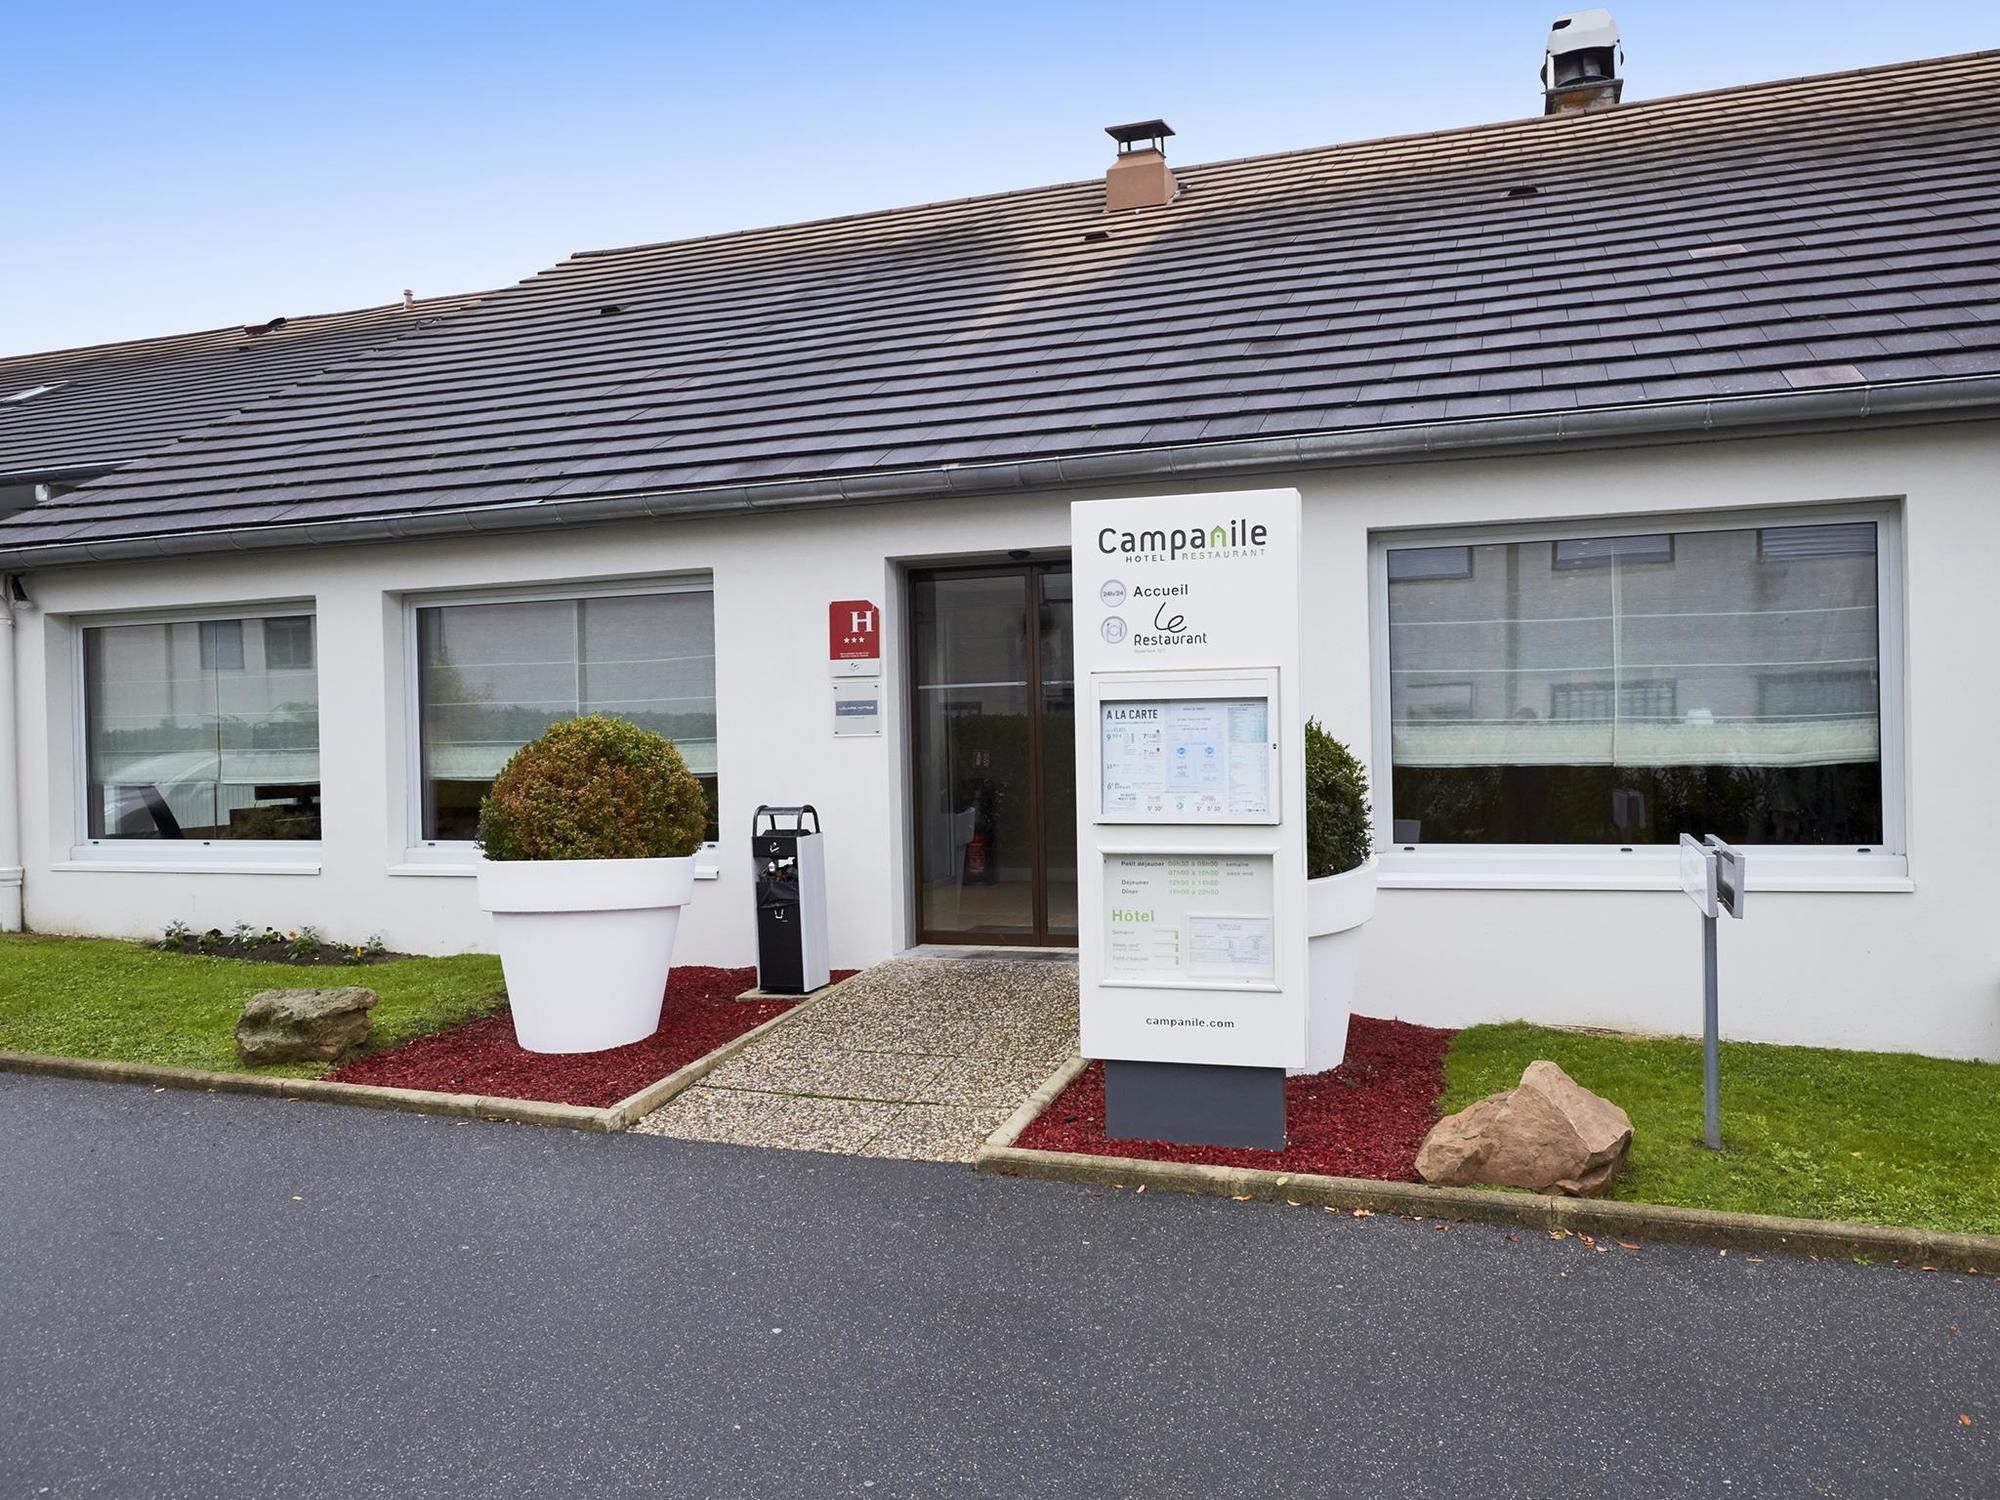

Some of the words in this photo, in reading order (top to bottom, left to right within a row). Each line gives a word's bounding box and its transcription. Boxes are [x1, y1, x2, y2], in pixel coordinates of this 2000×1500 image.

[1098, 519, 1268, 560] Campanile
[1126, 554, 1166, 563] HOTEL
[1182, 549, 1266, 560] RESTAURANT
[1133, 584, 1189, 597] Accueil
[850, 611, 874, 633] H
[1134, 632, 1207, 646] Restaurant
[1106, 710, 1112, 720] A
[1115, 710, 1126, 720] LA
[1129, 709, 1158, 719] CARTE
[1112, 909, 1154, 922] Hôtel
[1146, 1017, 1235, 1028] campanile.com
